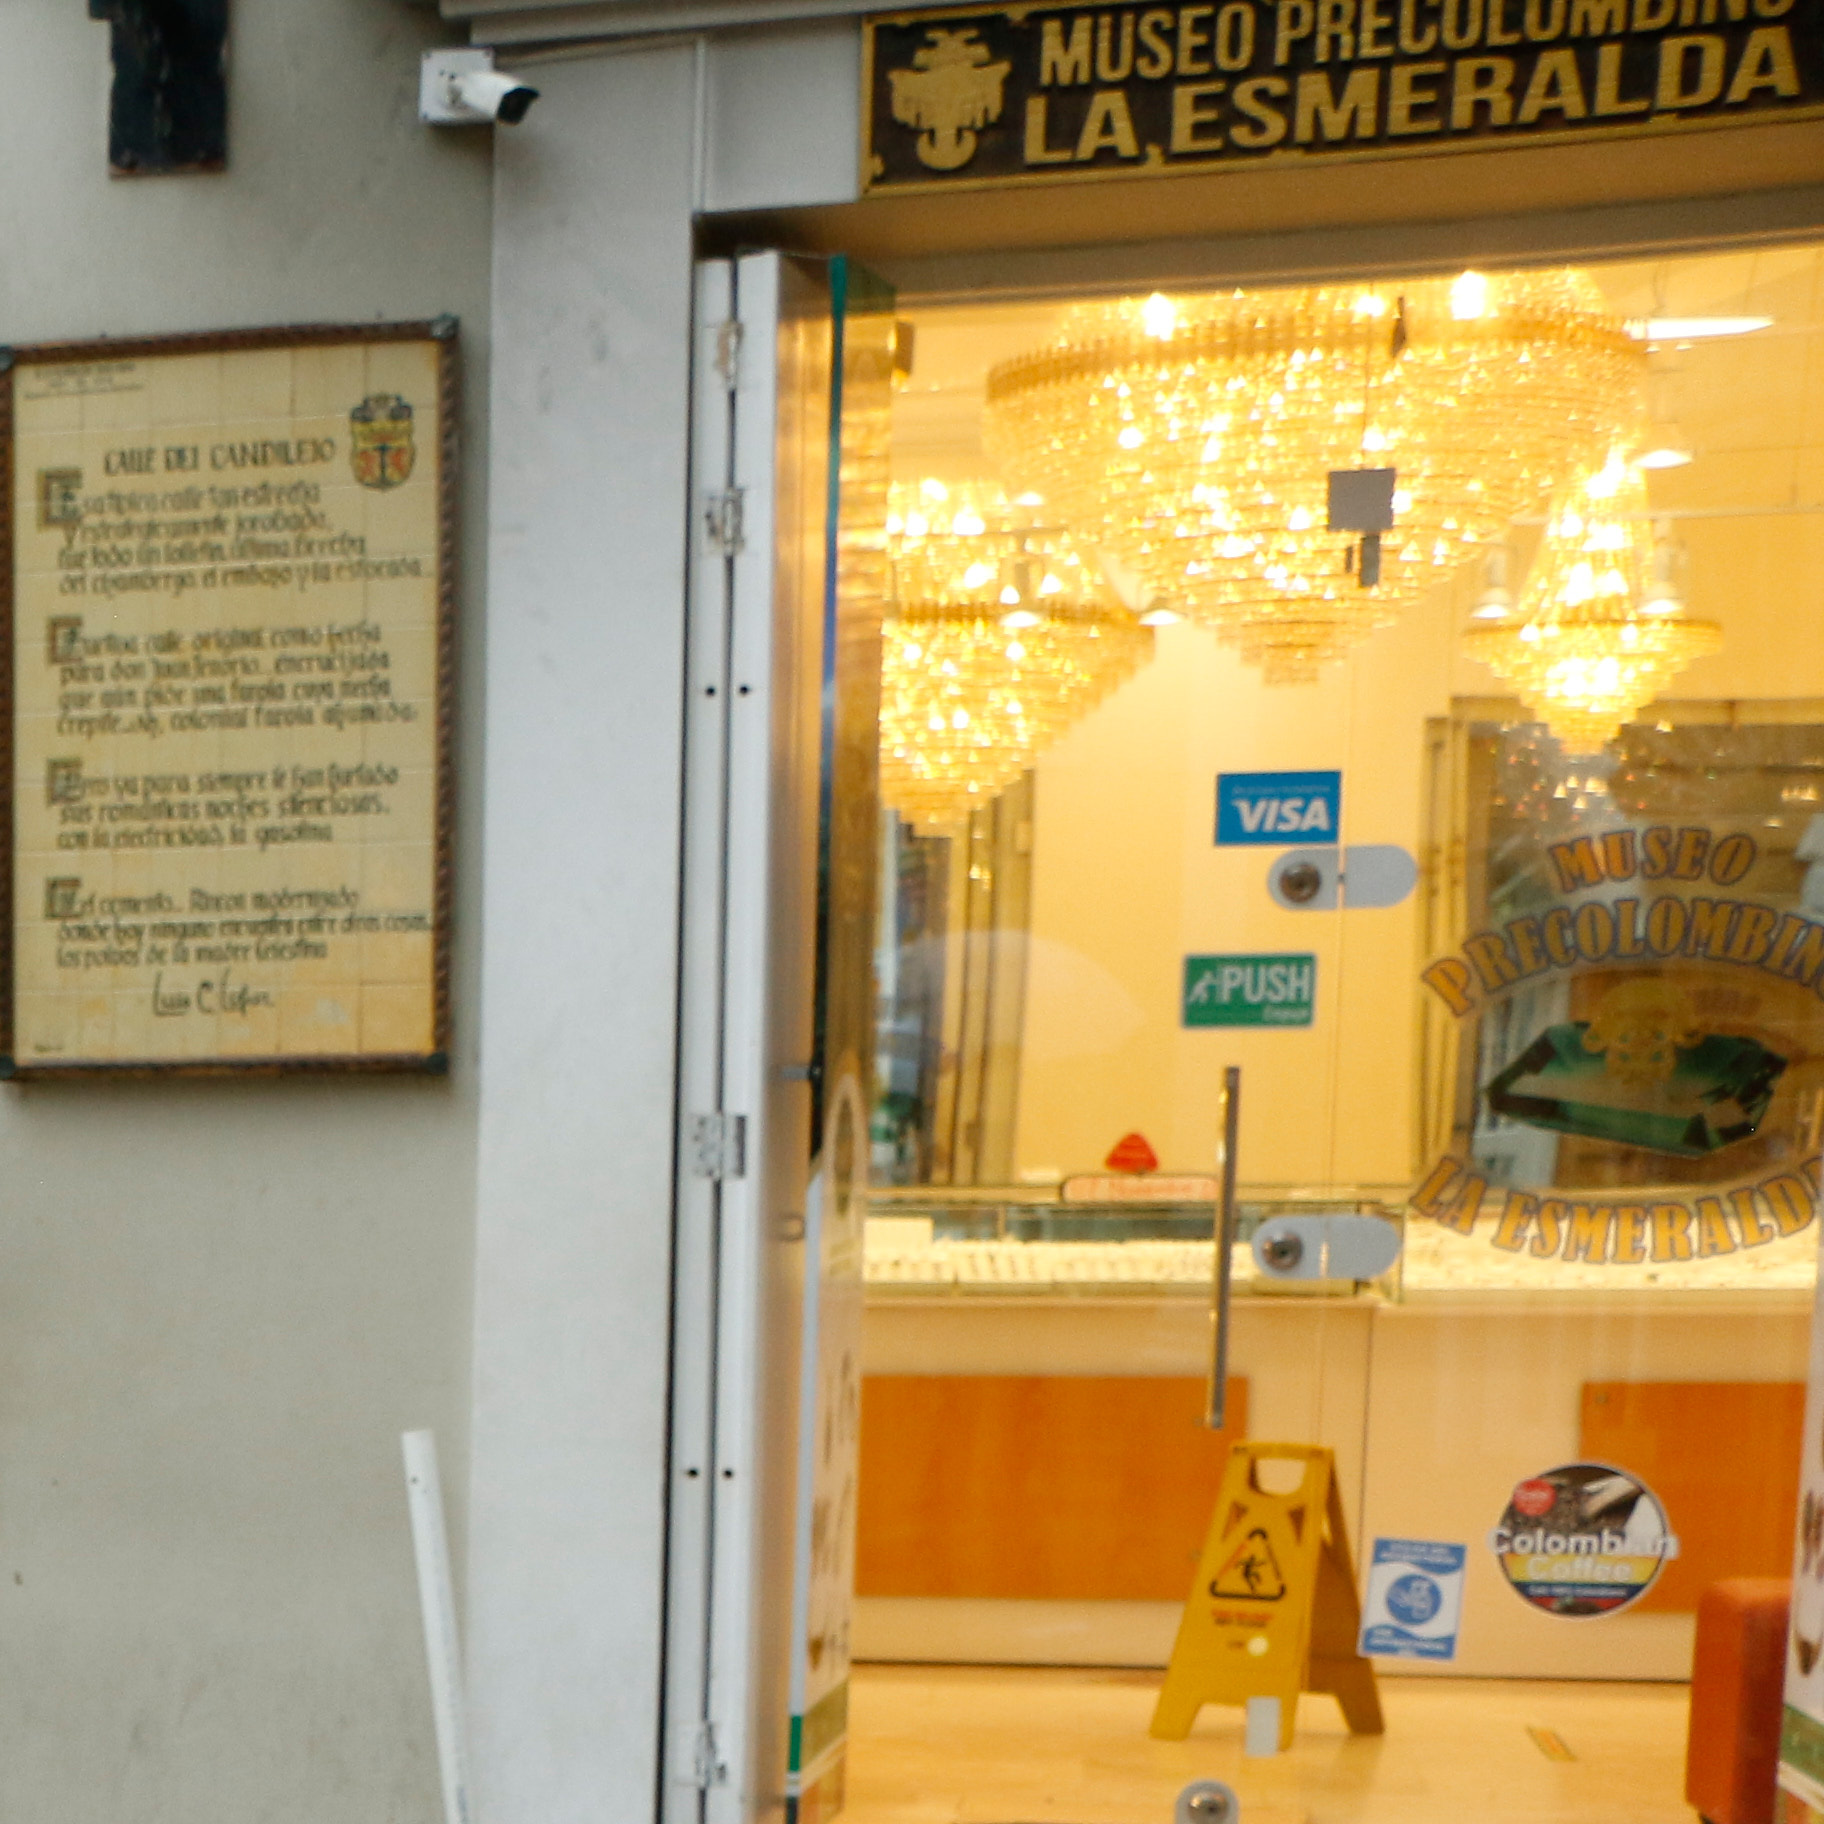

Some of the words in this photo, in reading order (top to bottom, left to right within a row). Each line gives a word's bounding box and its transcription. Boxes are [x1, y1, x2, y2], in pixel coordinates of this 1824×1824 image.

[1038, 4, 1253, 87] MUSEO
[1274, 0, 1796, 67] PRECOLOM
[1023, 90, 1139, 166] LA
[1170, 26, 1801, 155] ESMERALDA
[1232, 797, 1331, 833] VISA
[1549, 825, 1756, 894] MUSEO
[1222, 964, 1312, 1004] PUSH
[1421, 895, 1824, 1018] PRECOLOMBIN
[1411, 1155, 1490, 1238] LA
[1488, 1524, 1679, 1559] Colombn
[1526, 1555, 1634, 1582] Coffee
